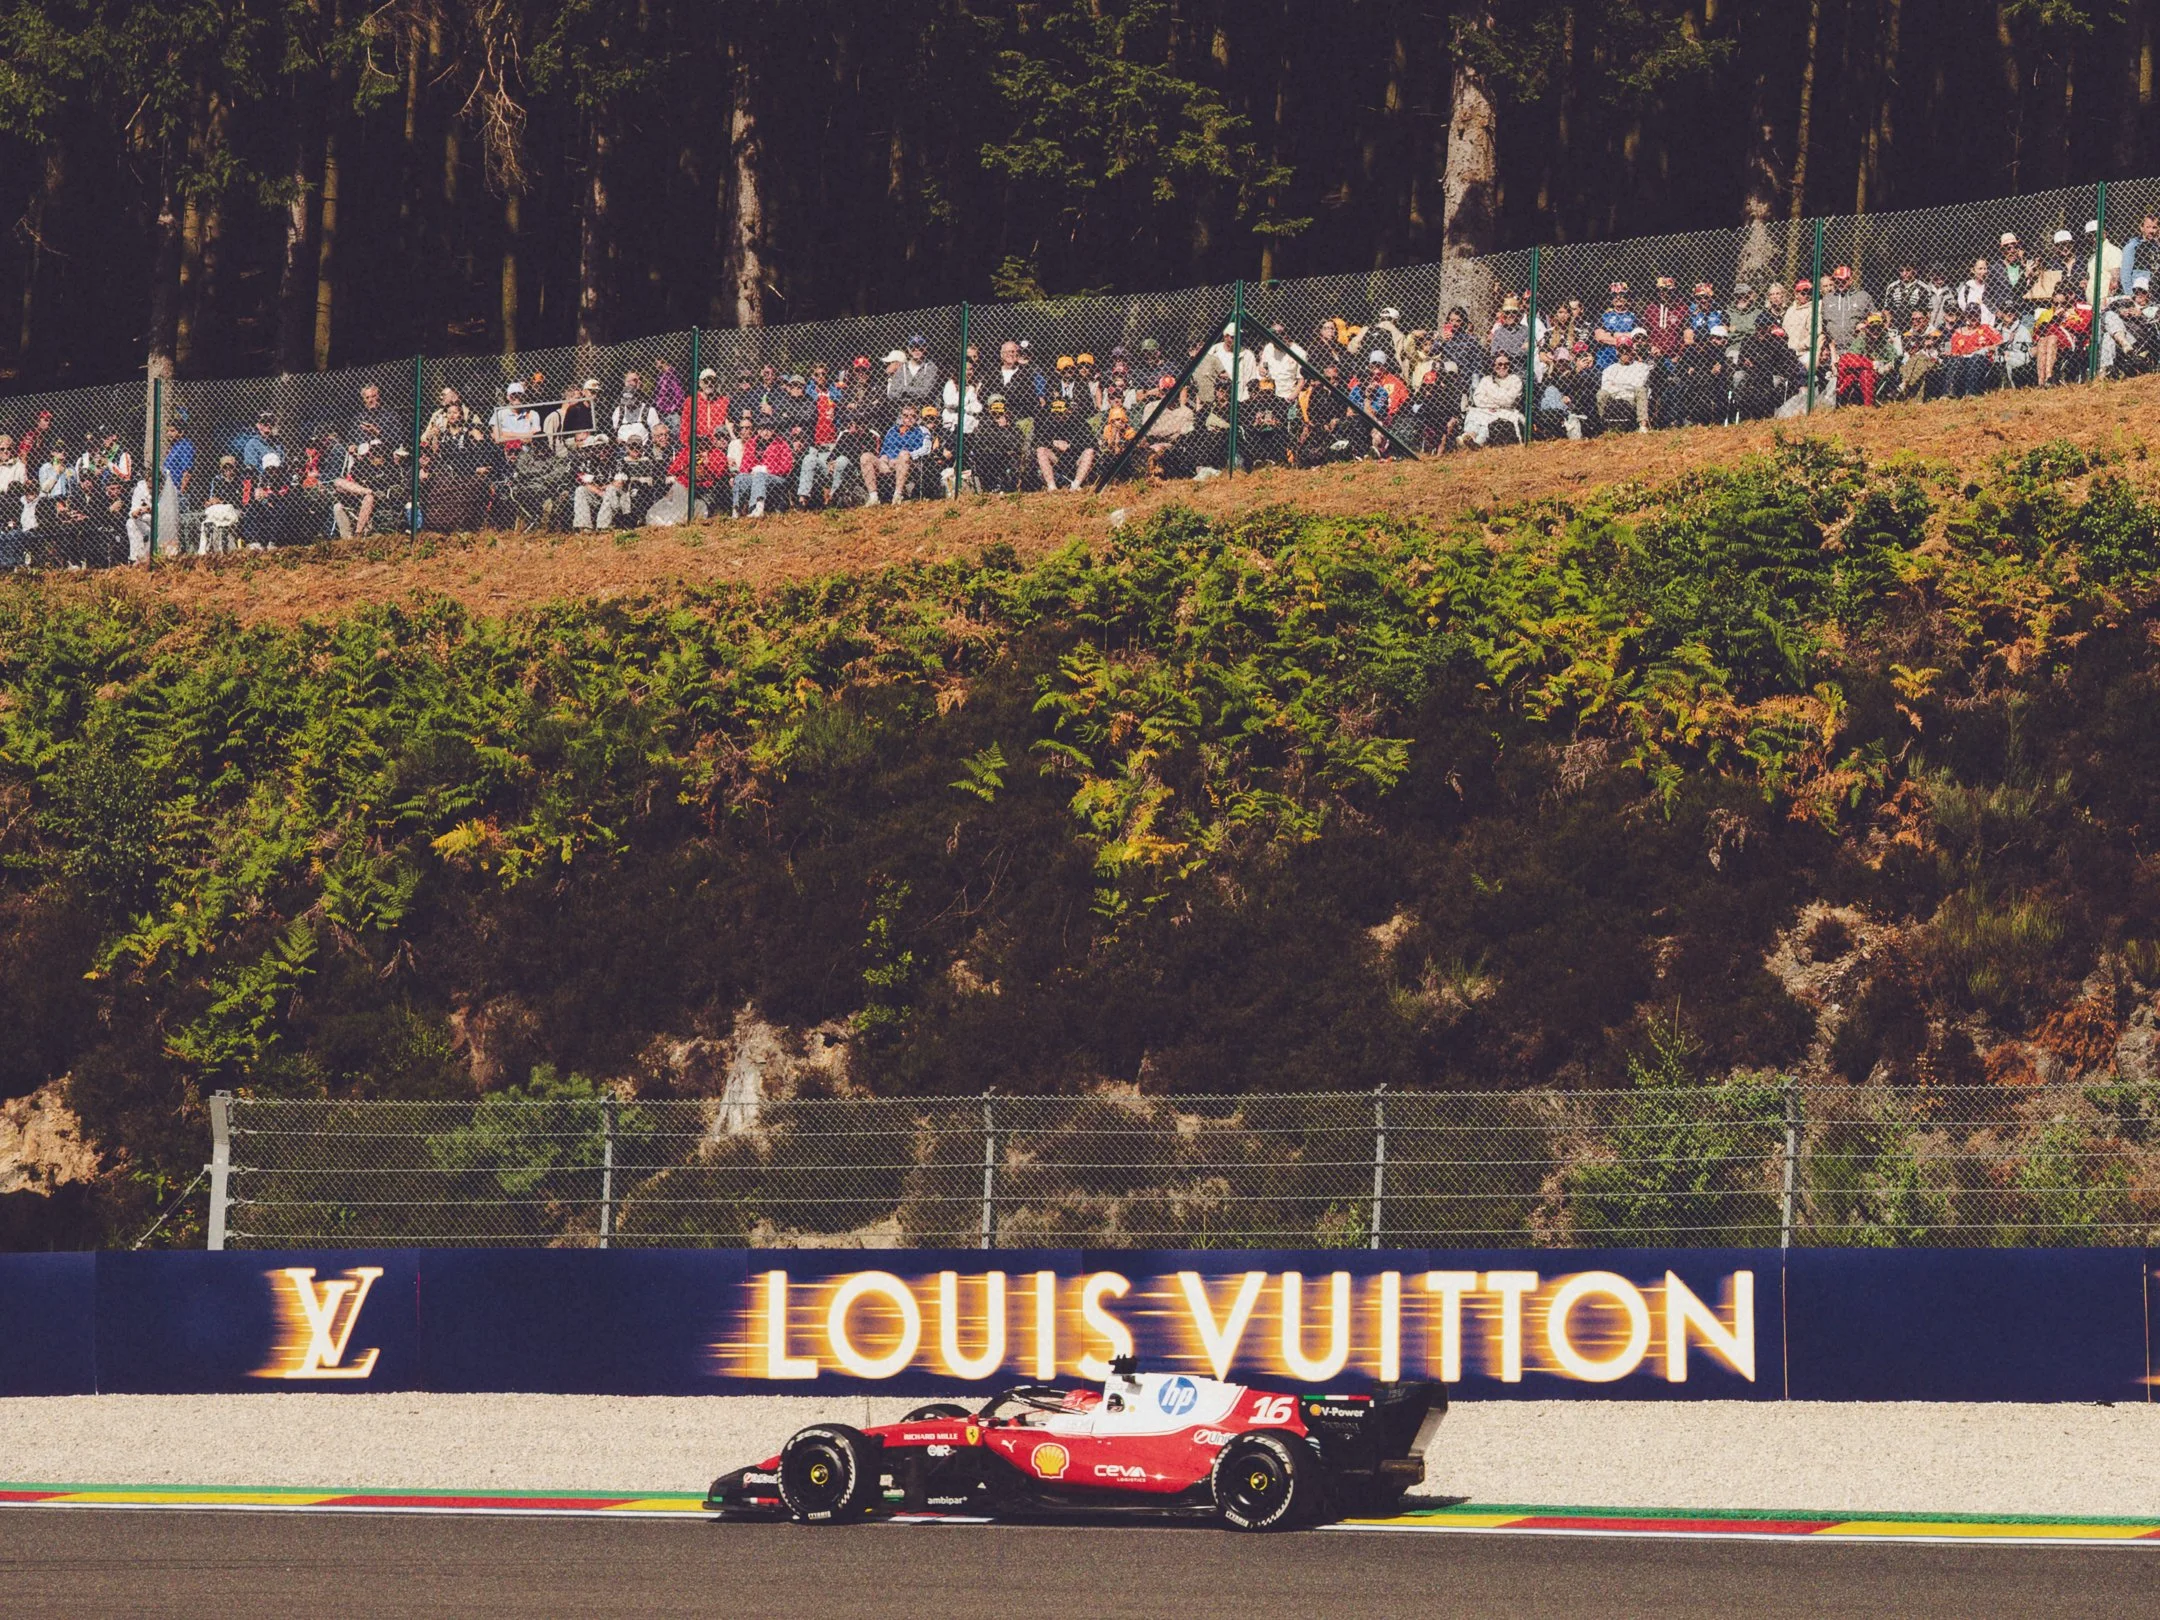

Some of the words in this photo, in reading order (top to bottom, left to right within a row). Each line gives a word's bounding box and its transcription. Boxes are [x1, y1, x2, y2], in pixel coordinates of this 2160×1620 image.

[766, 1269, 1134, 1381] LOUIS
[1176, 1269, 1755, 1383] VUITTON
[1160, 1375, 1196, 1416] hp
[1247, 1396, 1295, 1425] 16
[1321, 1406, 1365, 1418] V-Power
[903, 1433, 936, 1441] RICHARD
[936, 1433, 959, 1441] MILLE
